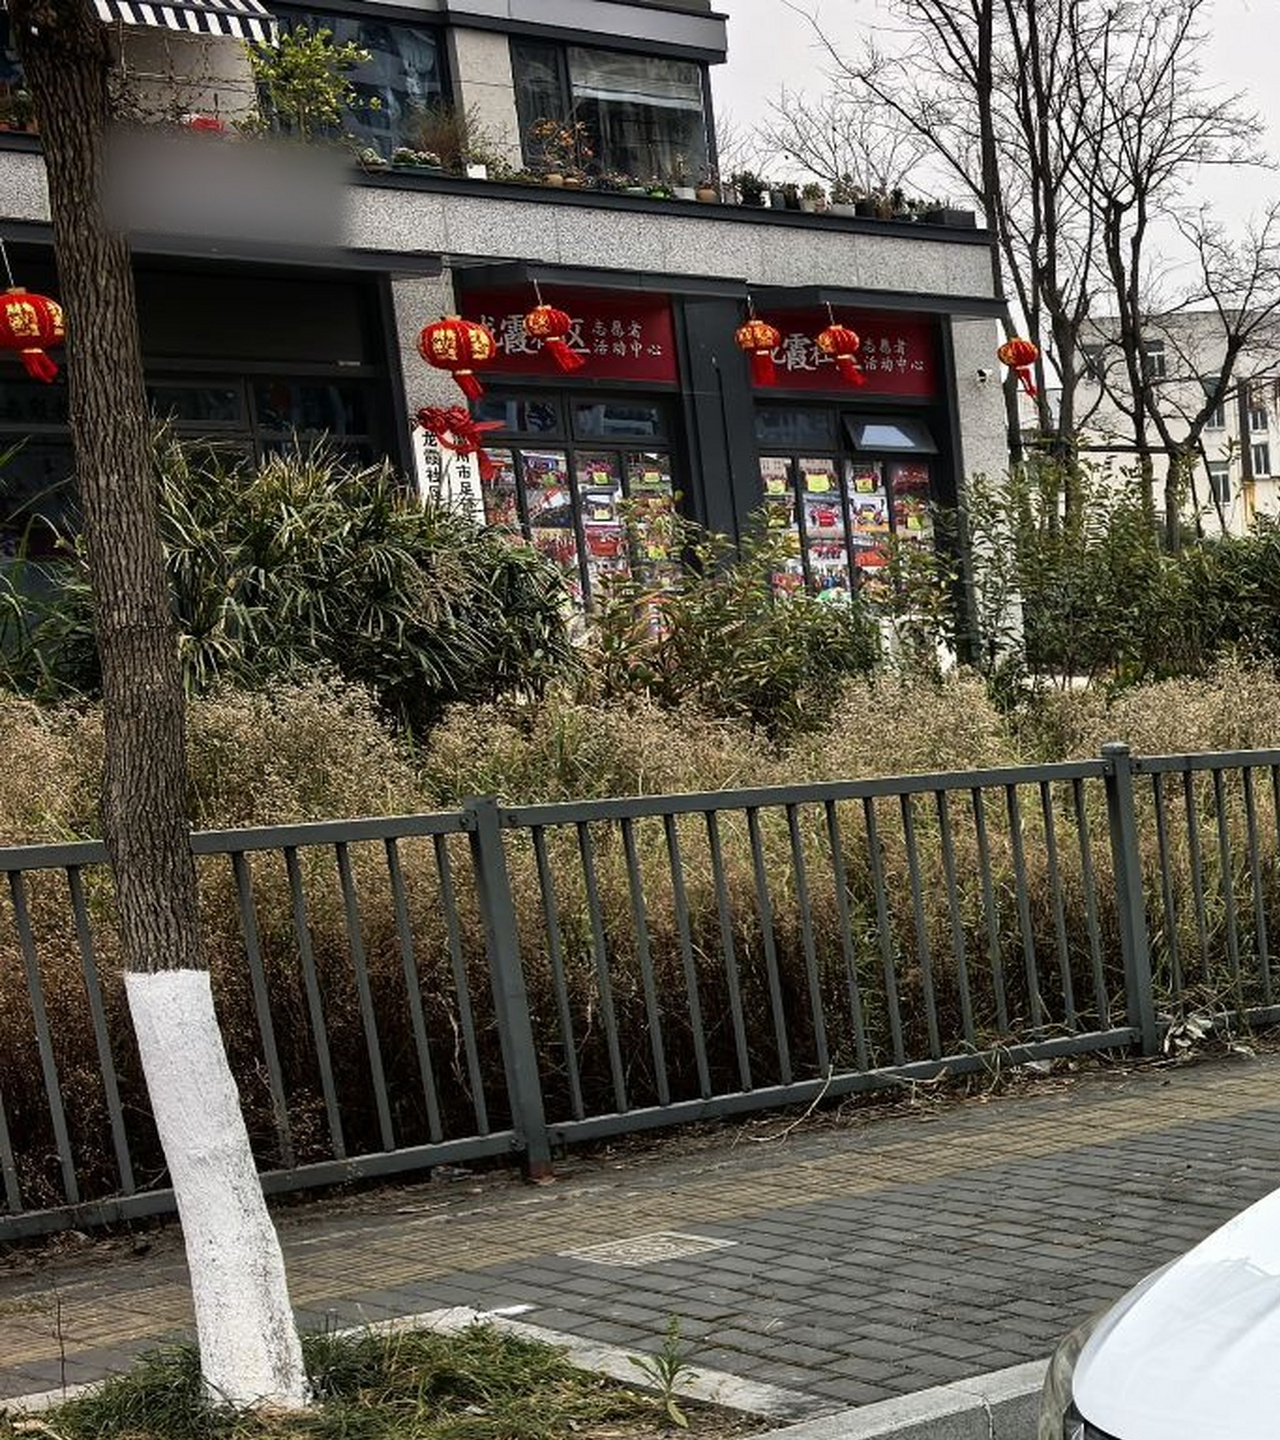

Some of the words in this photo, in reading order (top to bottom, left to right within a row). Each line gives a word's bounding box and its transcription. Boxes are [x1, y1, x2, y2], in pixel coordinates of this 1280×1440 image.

[593, 339, 662, 358] 活动中心
[863, 355, 924, 373] 活动中心
